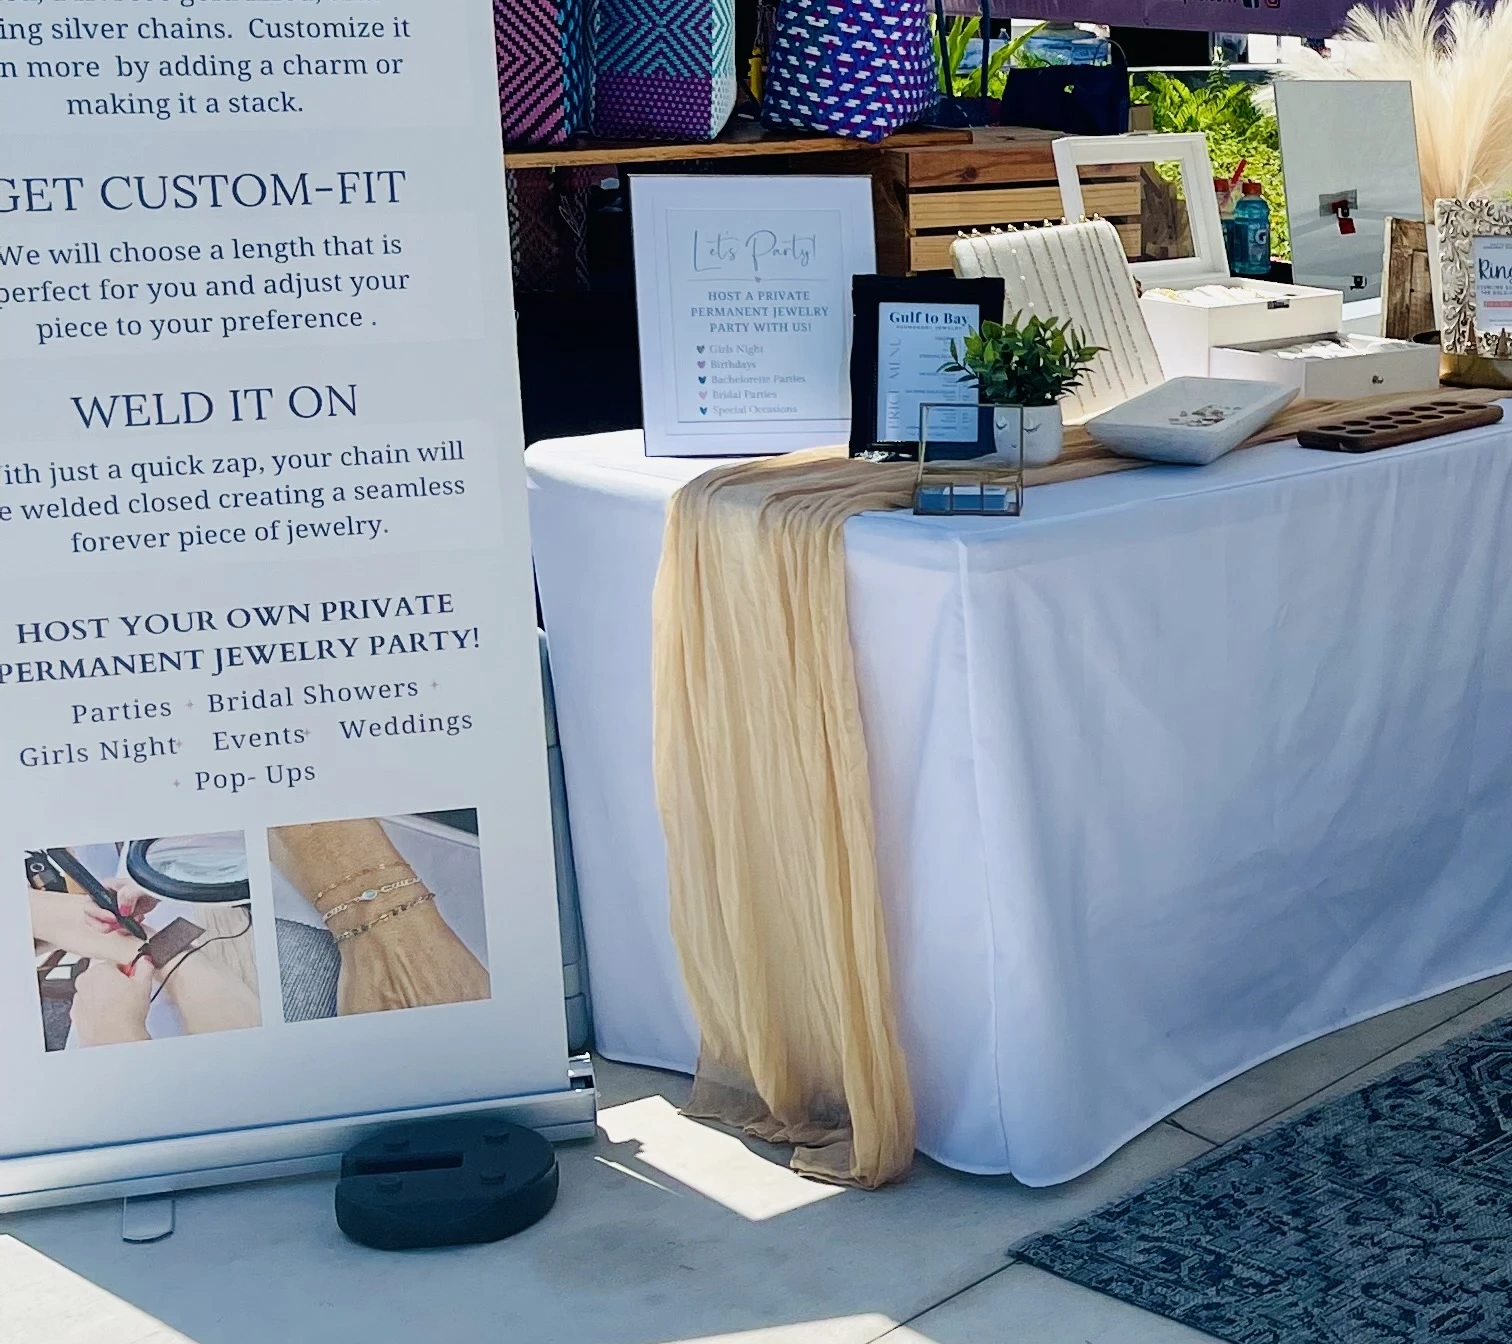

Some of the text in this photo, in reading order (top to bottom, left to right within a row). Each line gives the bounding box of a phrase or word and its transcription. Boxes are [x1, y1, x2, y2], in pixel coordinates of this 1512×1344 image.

[0, 17, 410, 45] ing silver chains. Customize it
[27, 62, 99, 77] more
[116, 56, 149, 82] by
[160, 55, 251, 81] adding
[261, 60, 273, 75] a
[284, 54, 367, 75] charm
[377, 59, 403, 74] or
[67, 92, 302, 120] making it a stack.
[0, 171, 405, 212] GET CUSTOM-FIT
[0, 235, 401, 265] We will choose a length that is
[100, 279, 138, 299] for
[147, 282, 196, 304] you
[207, 275, 254, 296] and
[265, 273, 341, 298] adjust
[350, 275, 409, 296] your
[708, 291, 810, 301] HOST A PRIVATE
[36, 318, 107, 344] piece
[117, 318, 141, 335] to
[150, 318, 212, 340] your
[221, 309, 362, 338] preference
[691, 307, 829, 318] PERMANENT JEWELRY
[710, 323, 812, 333] PARTY WITH US!
[890, 312, 968, 326] Gulf to Bay
[70, 385, 356, 428] WELD IT ON
[0, 441, 464, 488] ith just a quick zap, your chain will
[20, 495, 119, 519] welded
[129, 490, 210, 513] closed
[220, 485, 325, 508] creating
[333, 487, 345, 501] a
[355, 477, 464, 500] seamless
[73, 516, 387, 552] forever piece of jewelry.
[17, 594, 453, 643] HOST YOUR OWN PRIVATE
[0, 628, 478, 684] PERMANENT JEWELRY PARTY!
[72, 682, 417, 724] Parties Bridal Showers
[20, 714, 472, 766] Girls Night Events Weddings
[196, 765, 315, 793] Pop- Ups
